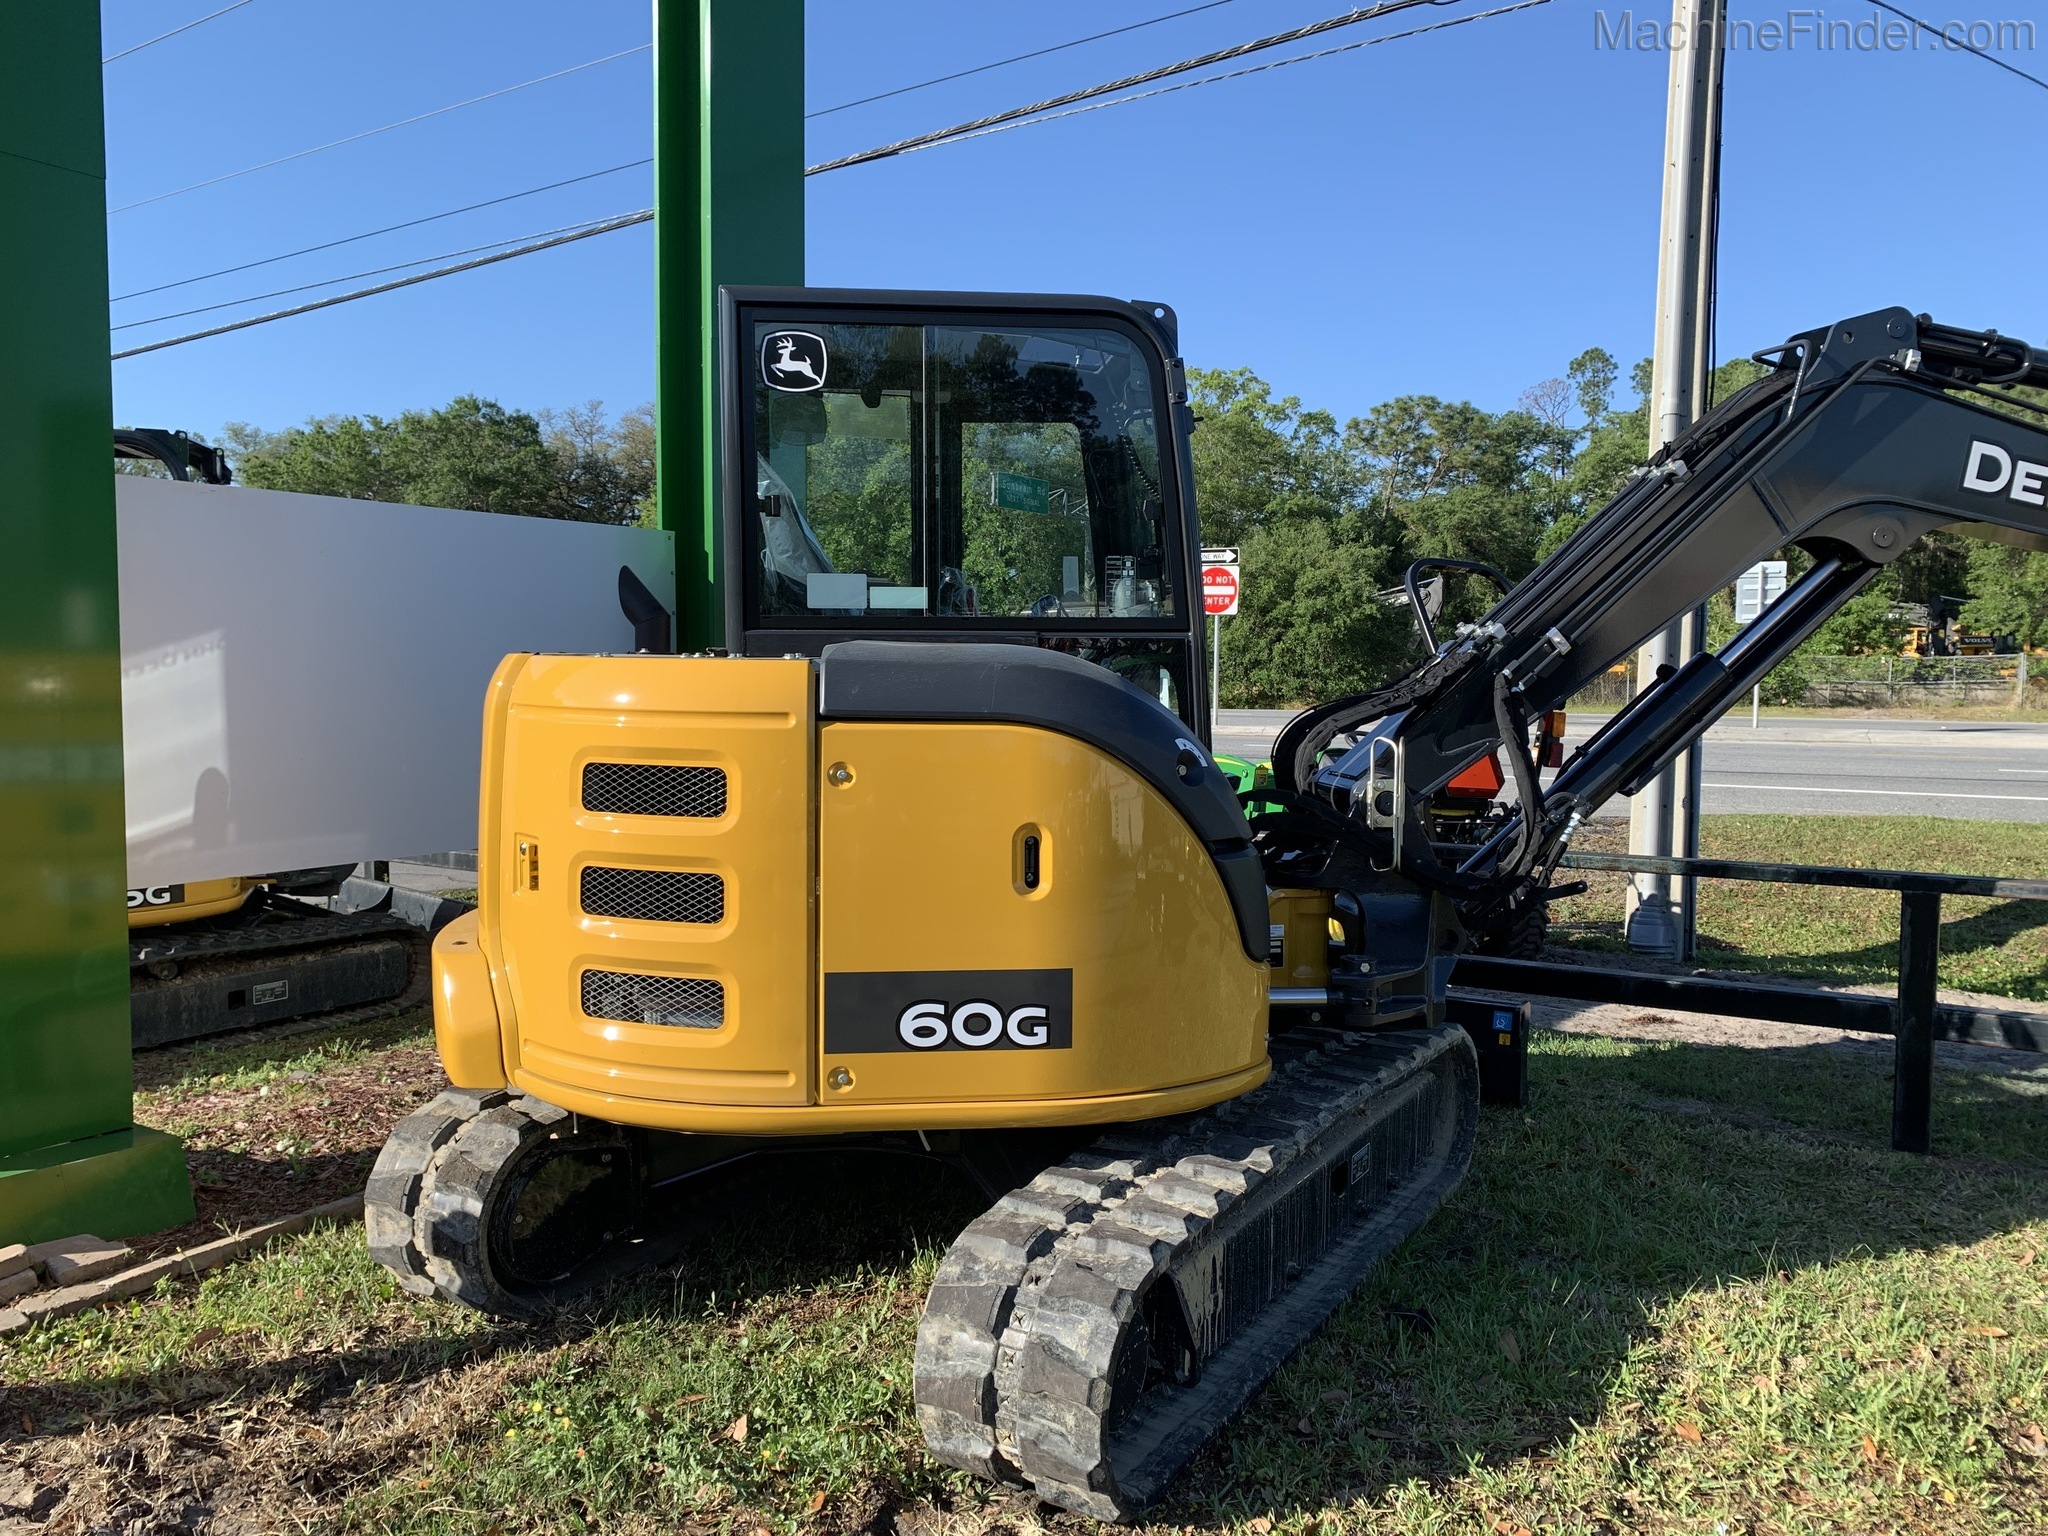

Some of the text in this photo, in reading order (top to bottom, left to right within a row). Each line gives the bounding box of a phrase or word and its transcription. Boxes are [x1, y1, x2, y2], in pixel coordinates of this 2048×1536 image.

[1002, 480, 1033, 493] Sunbeam
[1204, 597, 1231, 605] NTER
[899, 1002, 1048, 1048] 60G
